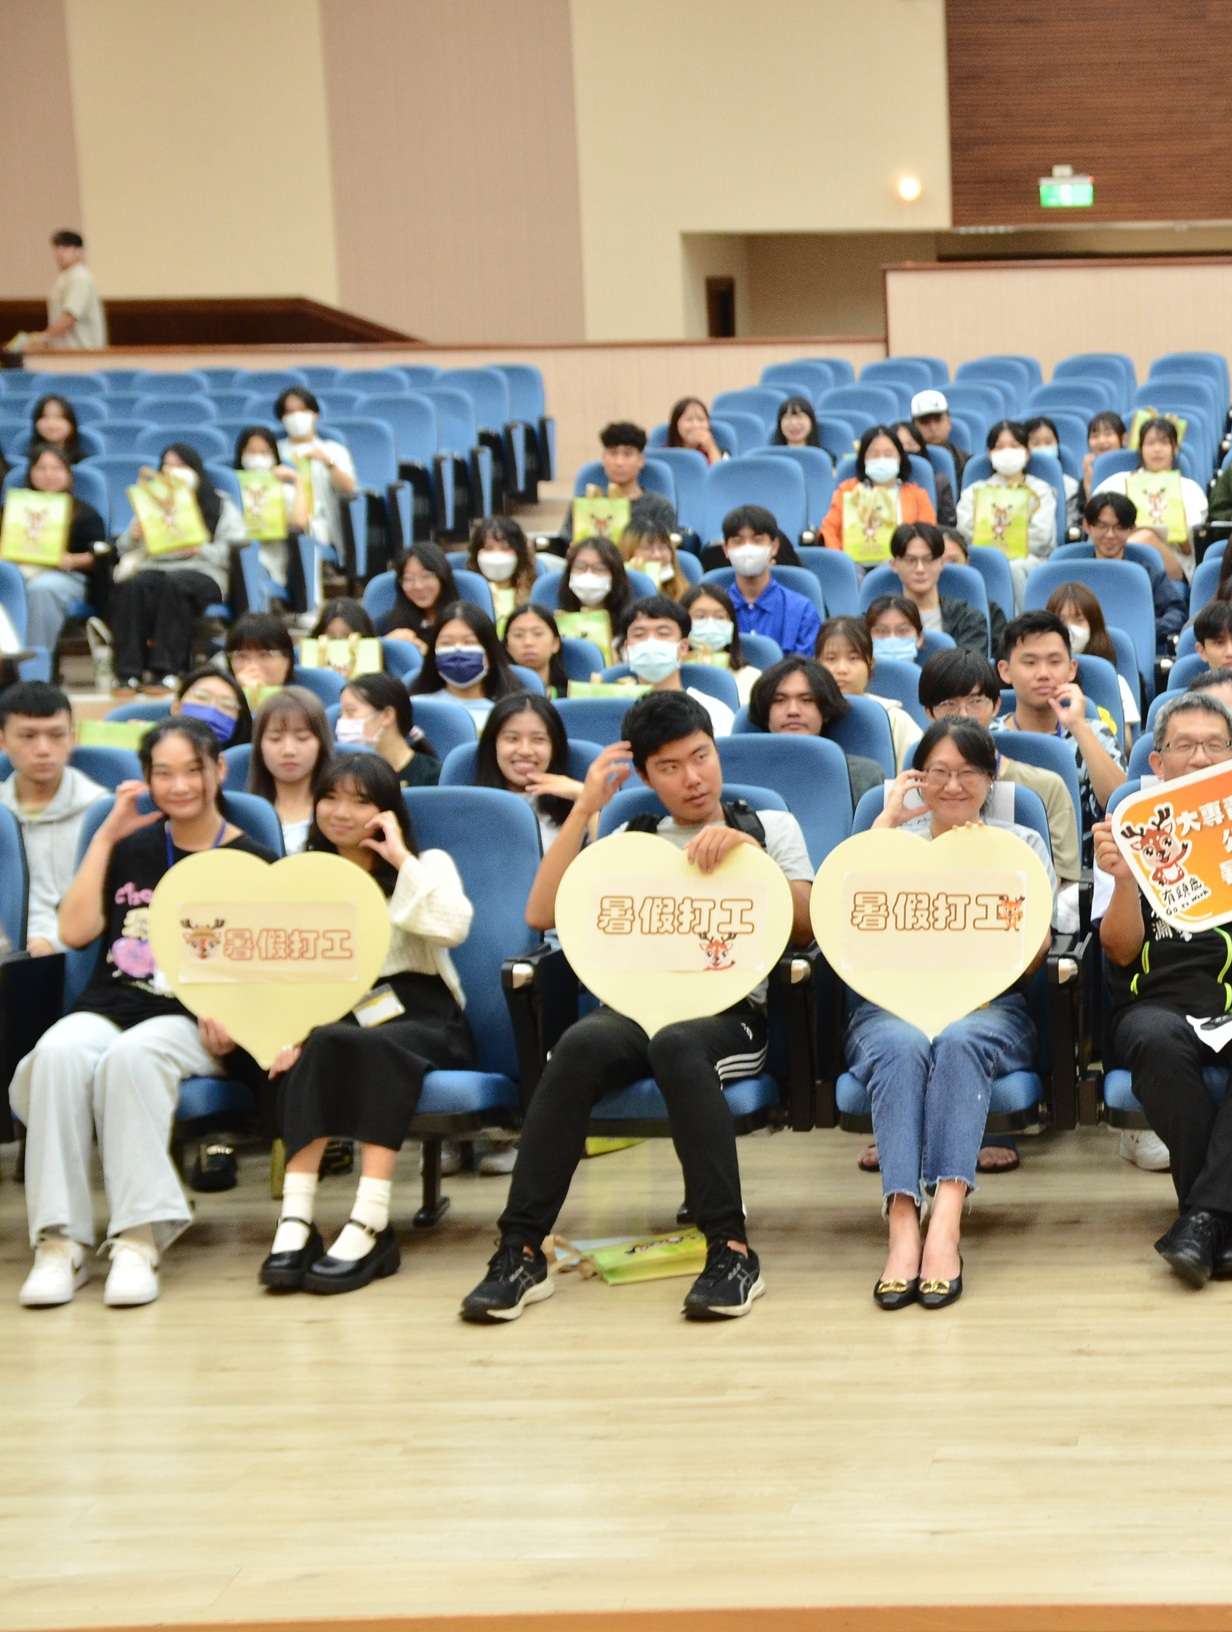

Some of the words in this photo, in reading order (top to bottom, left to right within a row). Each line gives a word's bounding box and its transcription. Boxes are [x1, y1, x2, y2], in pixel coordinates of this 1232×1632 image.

[597, 895, 755, 935] 暑假打工
[851, 892, 1011, 931] 暑假打工
[223, 928, 353, 960] 暑假打工
